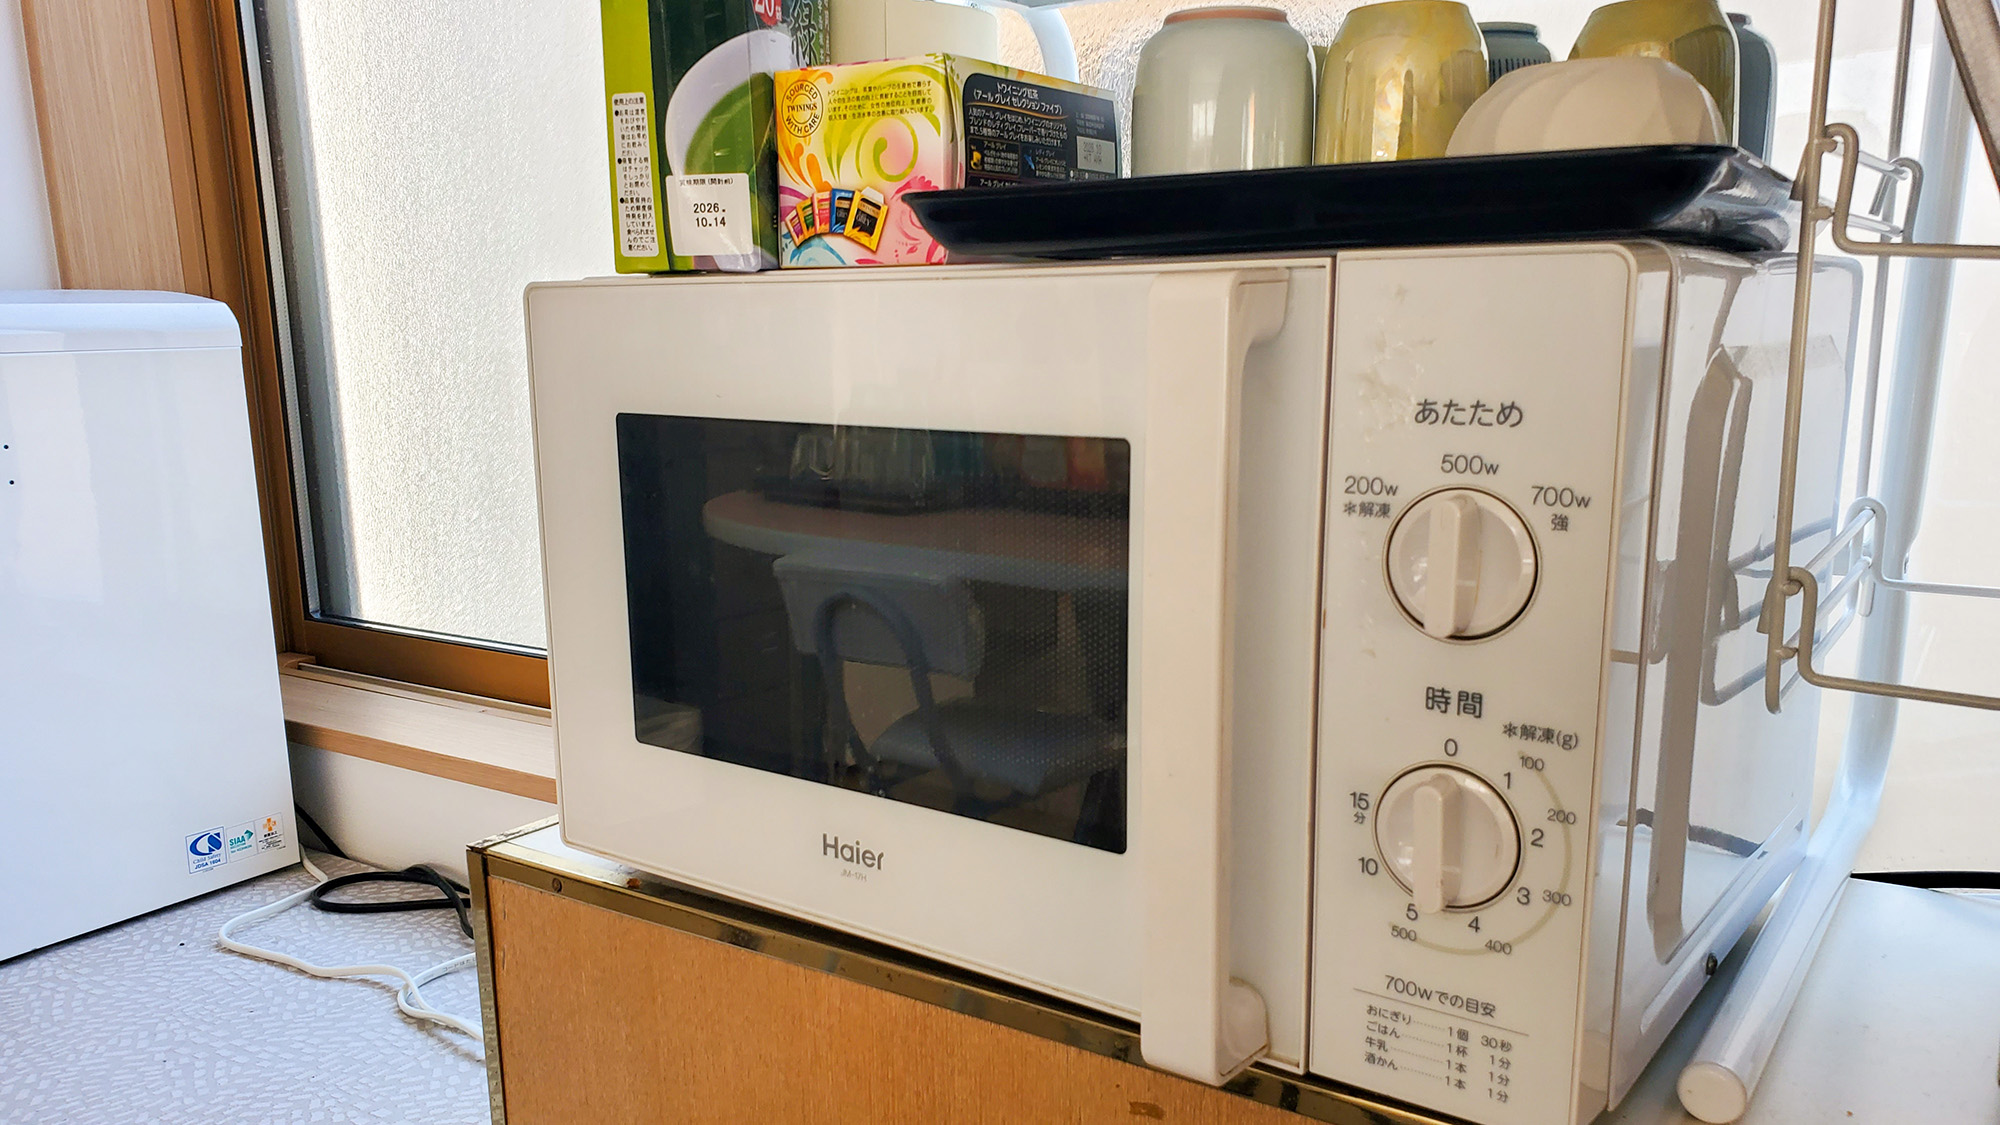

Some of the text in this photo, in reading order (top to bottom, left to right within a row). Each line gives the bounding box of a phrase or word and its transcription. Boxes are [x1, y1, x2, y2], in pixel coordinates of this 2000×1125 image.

[786, 83, 818, 102] SOURCED
[997, 82, 1039, 100] トワイニング紅茶
[787, 103, 818, 113] TWININGS
[786, 112, 820, 135] WITH CARE
[693, 202, 726, 214] 2026.
[696, 216, 726, 228] 10.14
[1414, 398, 1523, 428] あたため
[1550, 512, 1569, 533] 強
[1425, 686, 1483, 719] 時間
[1444, 738, 1458, 758] 0
[1519, 755, 1545, 772] 100
[1503, 772, 1512, 790] 1
[1350, 791, 1370, 811] 15
[1353, 811, 1366, 825] 分
[1546, 808, 1577, 826] 200
[229, 835, 246, 847] SIAA
[1530, 828, 1544, 848] 2
[822, 832, 884, 871] Haier
[1358, 857, 1379, 876] 10
[1516, 886, 1531, 906] 3
[1541, 889, 1572, 907] 300
[1405, 902, 1419, 922] 5
[1390, 925, 1418, 942] 500
[1468, 916, 1481, 934] 4
[1484, 940, 1513, 956] 400
[1366, 1004, 1412, 1026] おにぎり
[1366, 1020, 1400, 1039] ごはん
[1365, 1036, 1388, 1052] 牛乳
[1364, 1052, 1398, 1071] 酒かん
